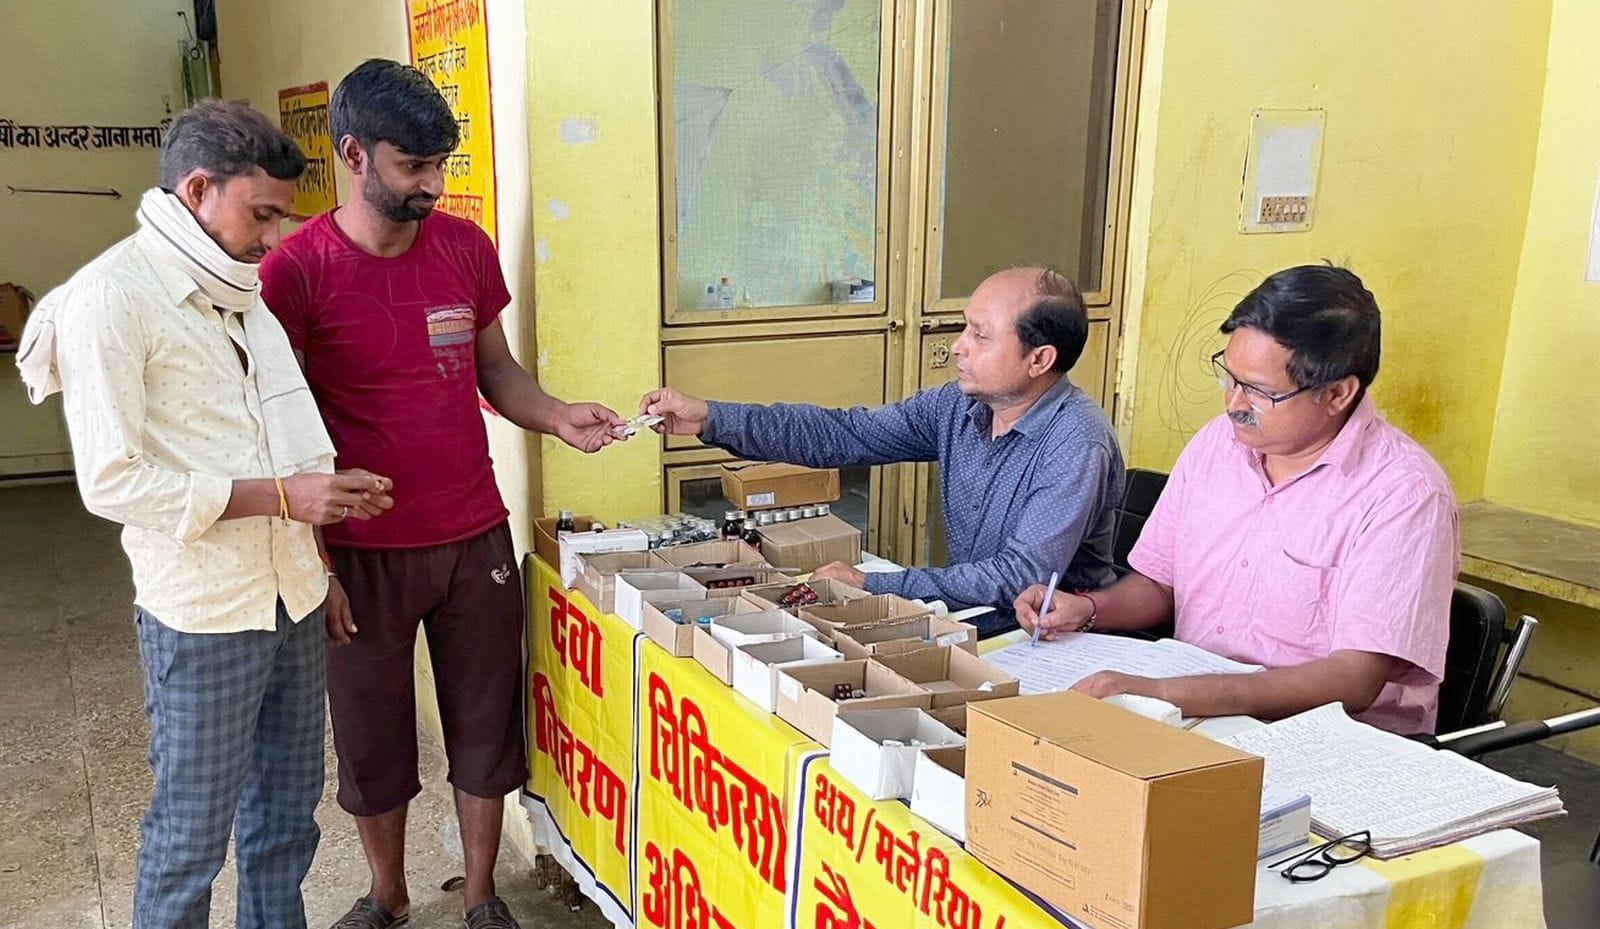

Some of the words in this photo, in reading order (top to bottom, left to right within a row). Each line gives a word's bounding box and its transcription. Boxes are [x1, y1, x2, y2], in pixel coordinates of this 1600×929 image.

[16, 126, 40, 148] का
[44, 126, 90, 150] अन्दर
[91, 126, 130, 148] जाना
[131, 127, 161, 147] मना
[548, 586, 604, 699] दवा
[533, 671, 627, 857] वितरण
[649, 671, 787, 895] चिकित्सा
[643, 841, 738, 929] अधि
